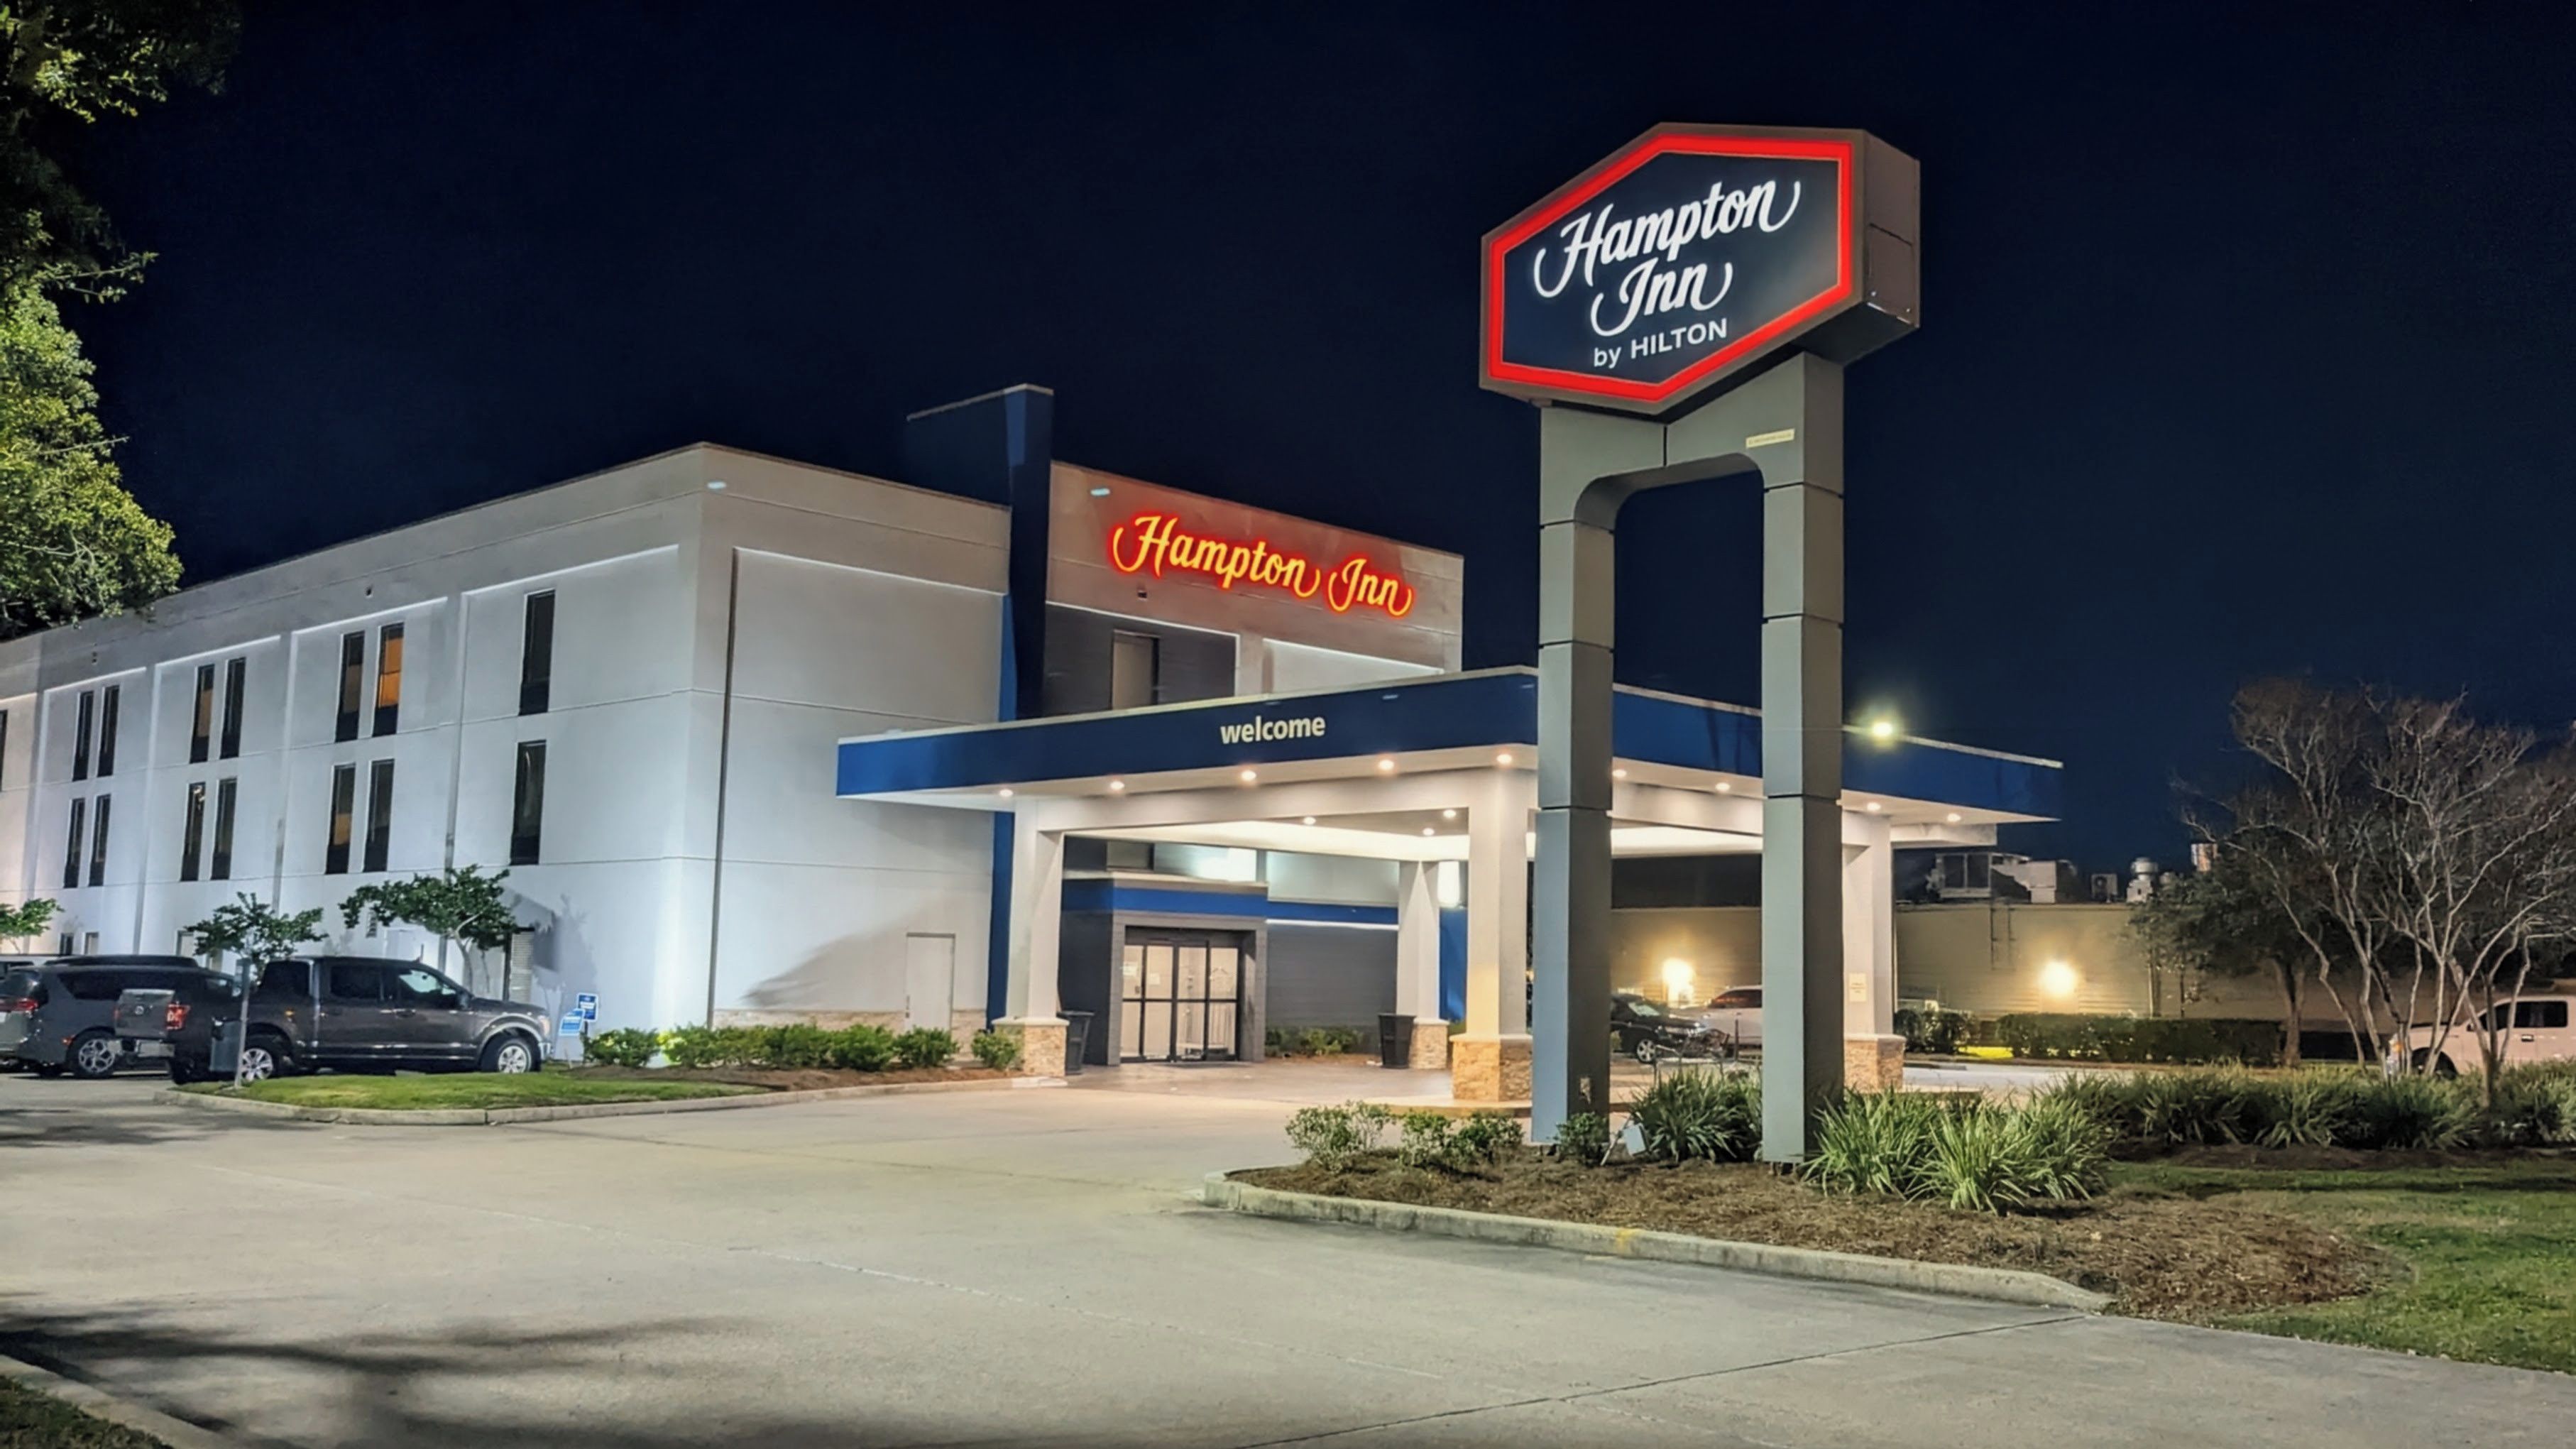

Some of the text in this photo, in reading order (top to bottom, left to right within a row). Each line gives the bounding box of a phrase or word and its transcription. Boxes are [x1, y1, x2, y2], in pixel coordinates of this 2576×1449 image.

[1533, 179, 1802, 298] Hampton
[1589, 257, 1733, 337] Inn
[1593, 317, 1728, 368] by HILTON
[1112, 515, 1413, 617] Hampton Inn
[1220, 714, 1326, 745] welcome
